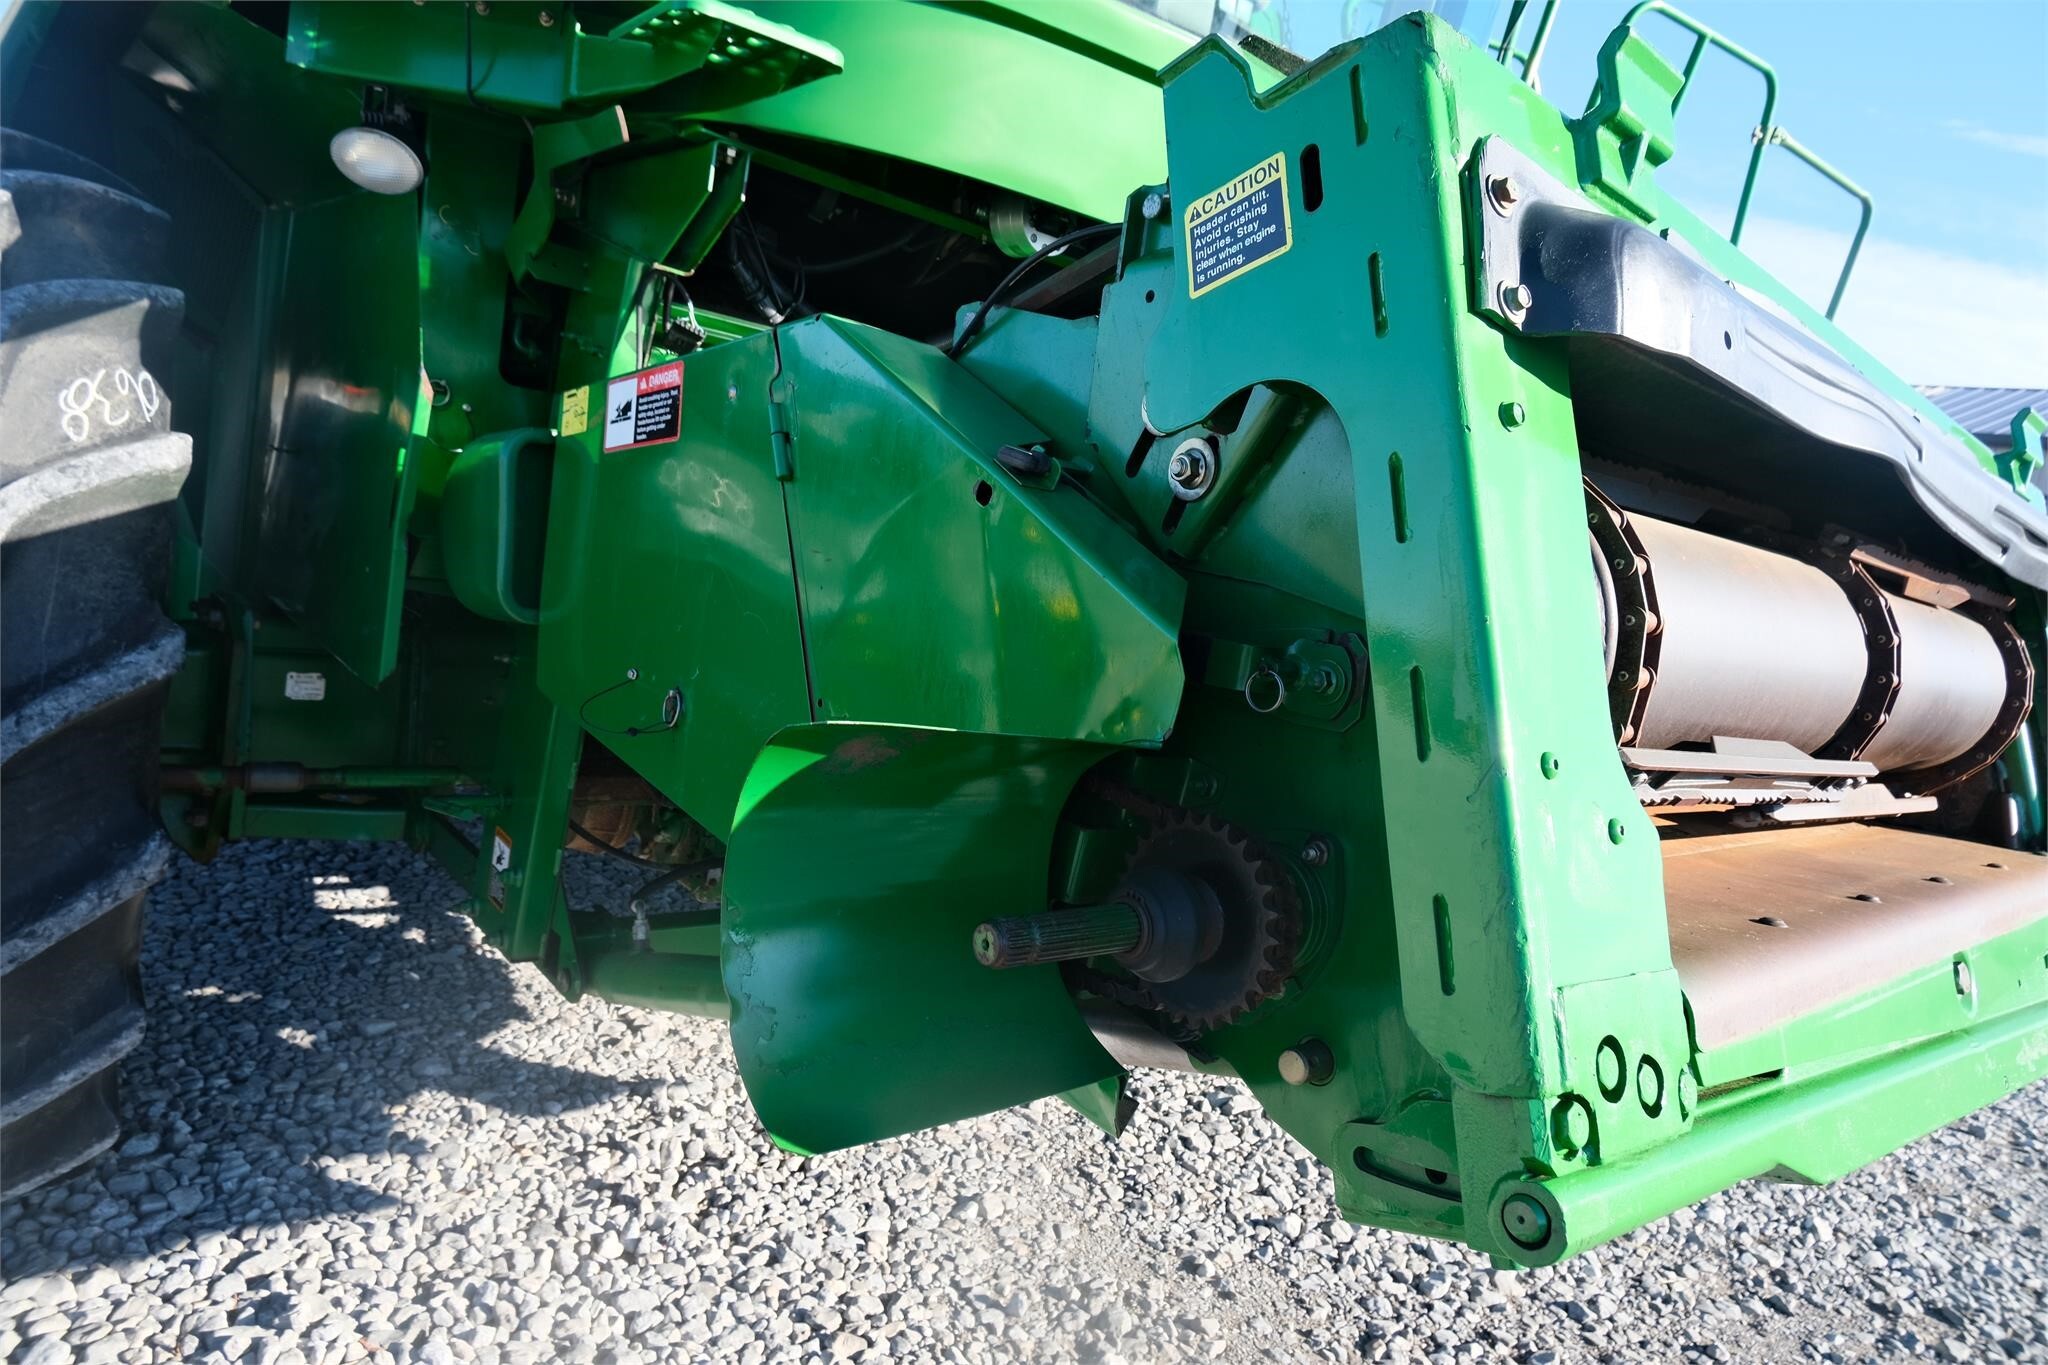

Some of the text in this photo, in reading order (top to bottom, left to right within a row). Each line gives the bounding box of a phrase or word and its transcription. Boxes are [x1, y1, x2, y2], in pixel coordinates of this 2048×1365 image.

[1202, 159, 1279, 215] CAUTION
[1194, 190, 1269, 238] Header can tilt.
[1195, 203, 1267, 249] Avoid crushing
[1195, 220, 1259, 260] injuries. Stay
[1196, 224, 1276, 272] clear when engine
[1197, 253, 1245, 284] is running.
[649, 369, 680, 387] DANGER
